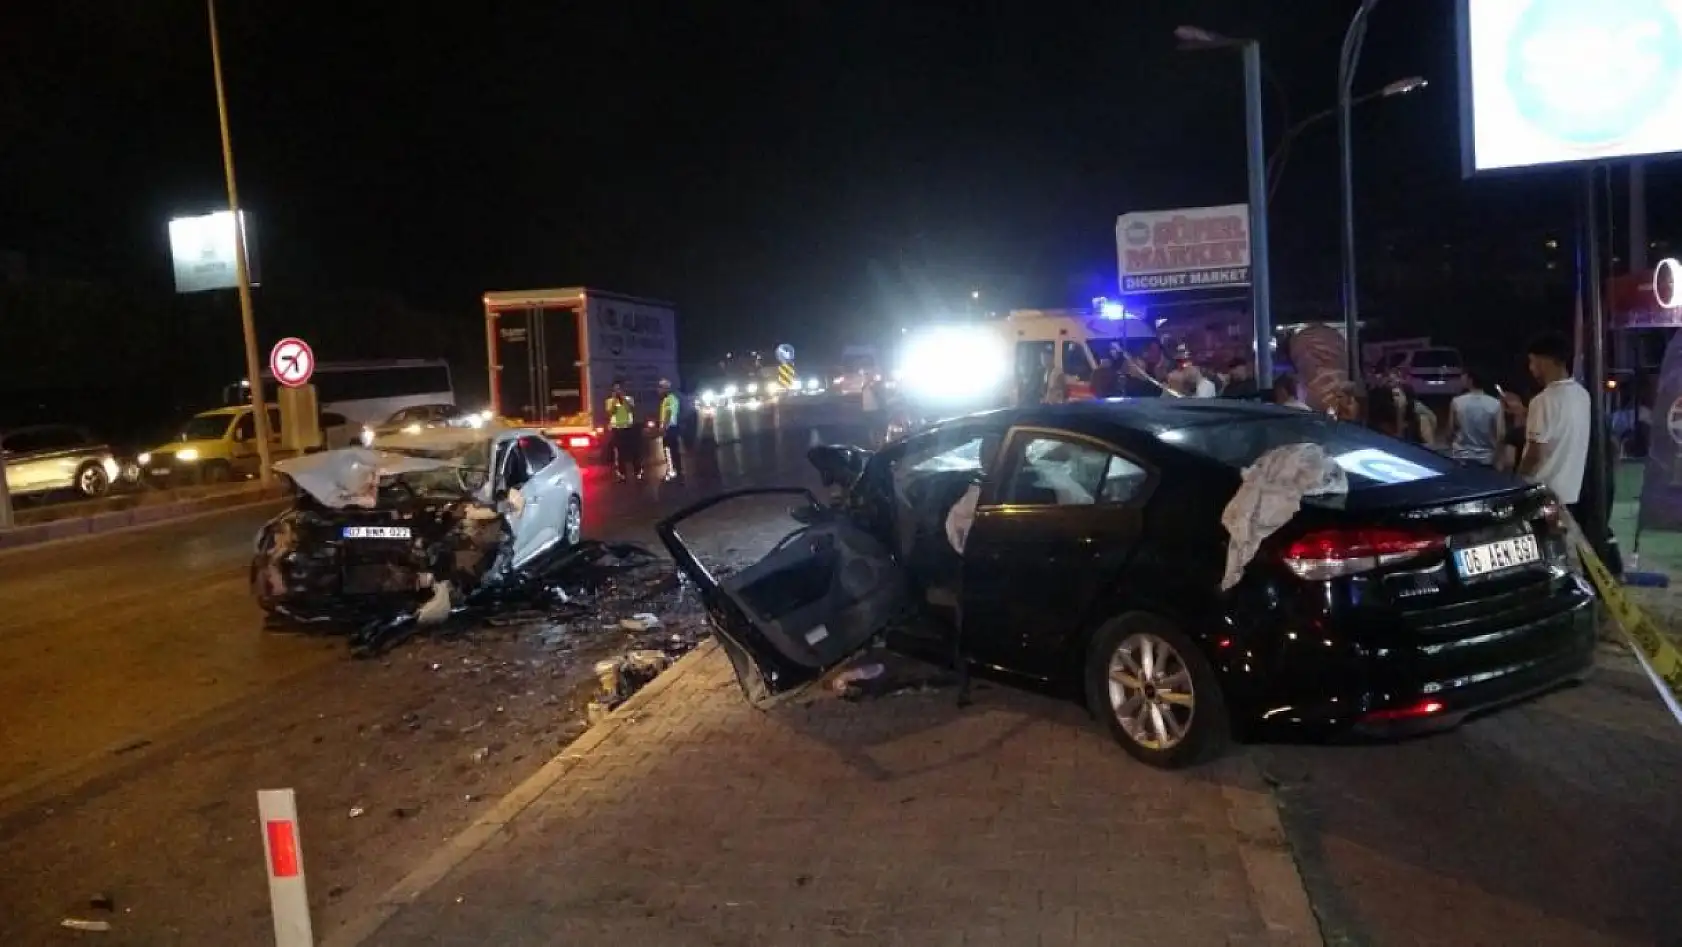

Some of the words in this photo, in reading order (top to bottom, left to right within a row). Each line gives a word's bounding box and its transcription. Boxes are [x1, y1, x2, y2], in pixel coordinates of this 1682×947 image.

[1125, 241, 1246, 272] MARKET
[1191, 268, 1247, 284] MARKET
[1463, 549, 1483, 573] 06
